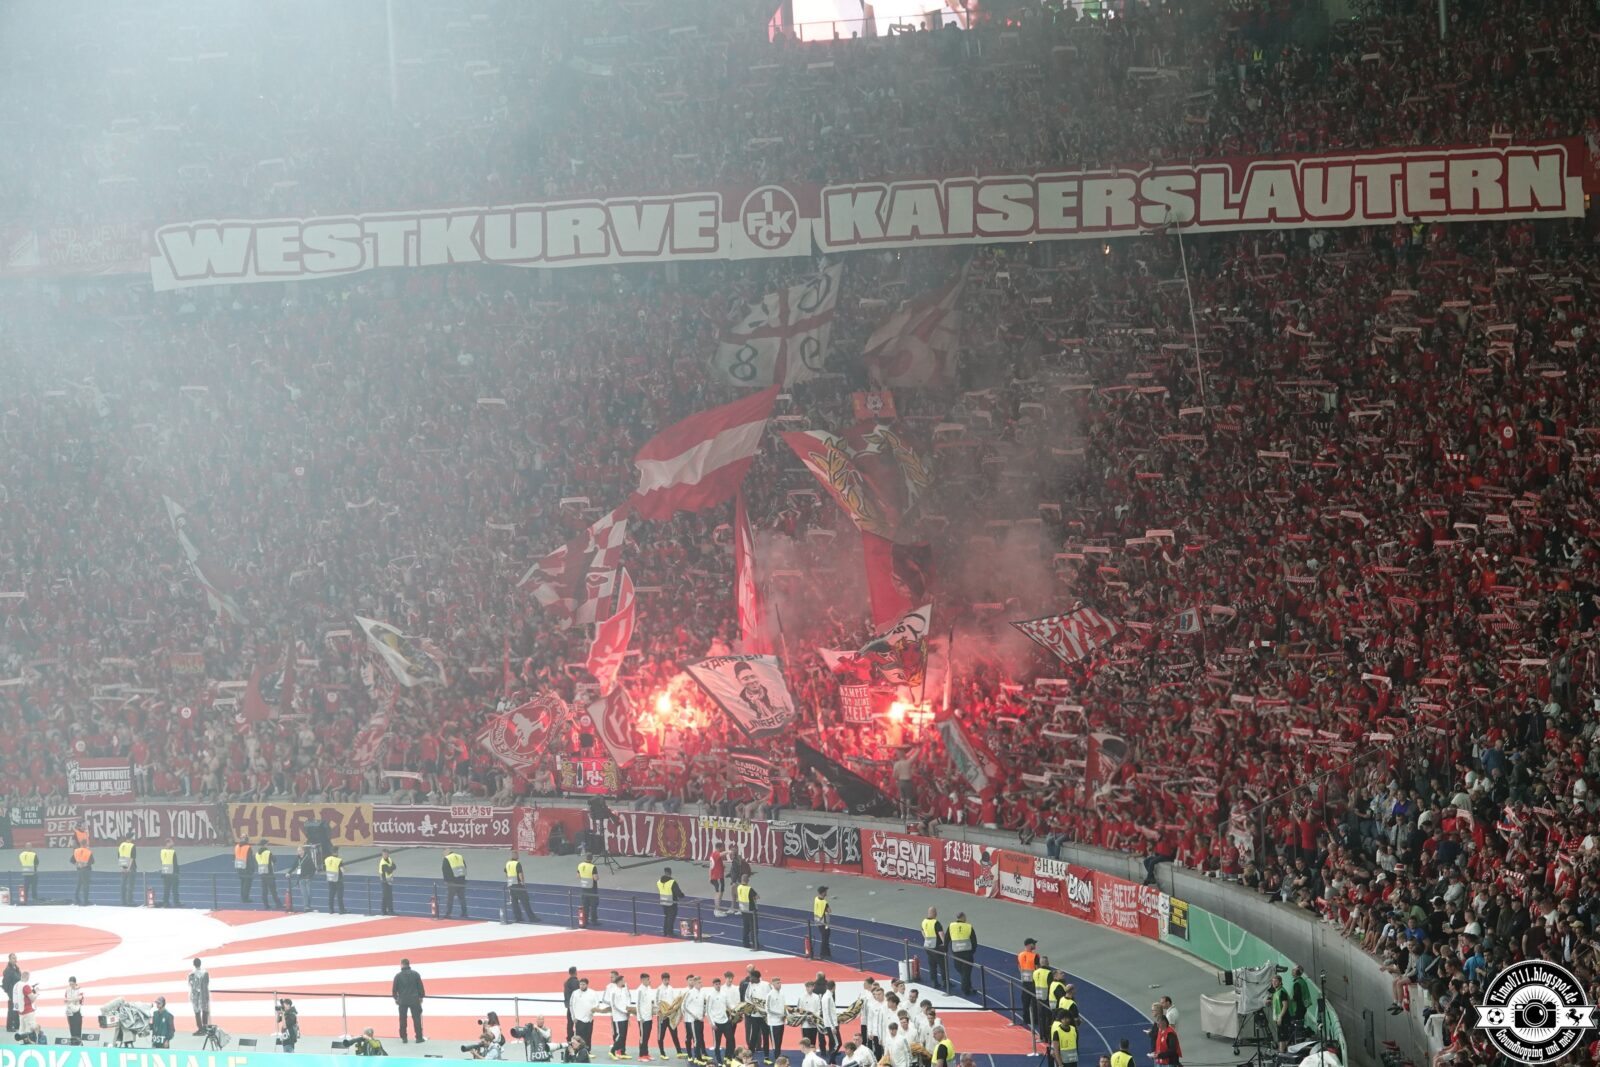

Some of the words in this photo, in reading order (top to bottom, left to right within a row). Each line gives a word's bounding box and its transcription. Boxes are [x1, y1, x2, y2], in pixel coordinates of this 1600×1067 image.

[158, 196, 721, 279] WESTKURVE
[824, 149, 1567, 246] KAISERSLAUTERN
[438, 818, 488, 839] Luzifer
